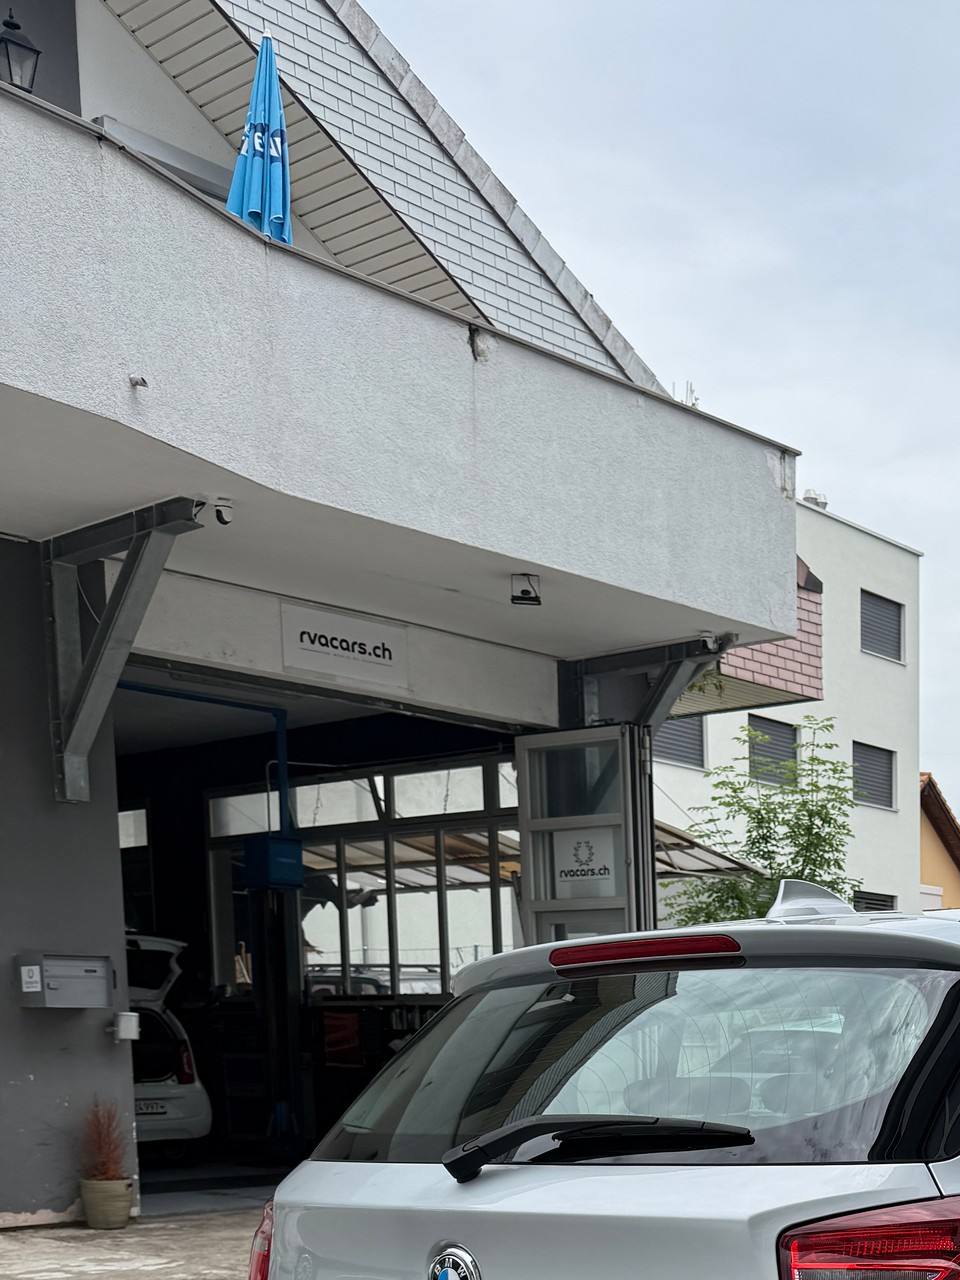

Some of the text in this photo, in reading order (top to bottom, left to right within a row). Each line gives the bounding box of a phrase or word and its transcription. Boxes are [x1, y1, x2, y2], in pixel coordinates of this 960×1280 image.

[300, 630, 392, 661] rvacars.ch
[560, 864, 611, 878] rvacars.ch
[434, 1257, 467, 1278] BMW
